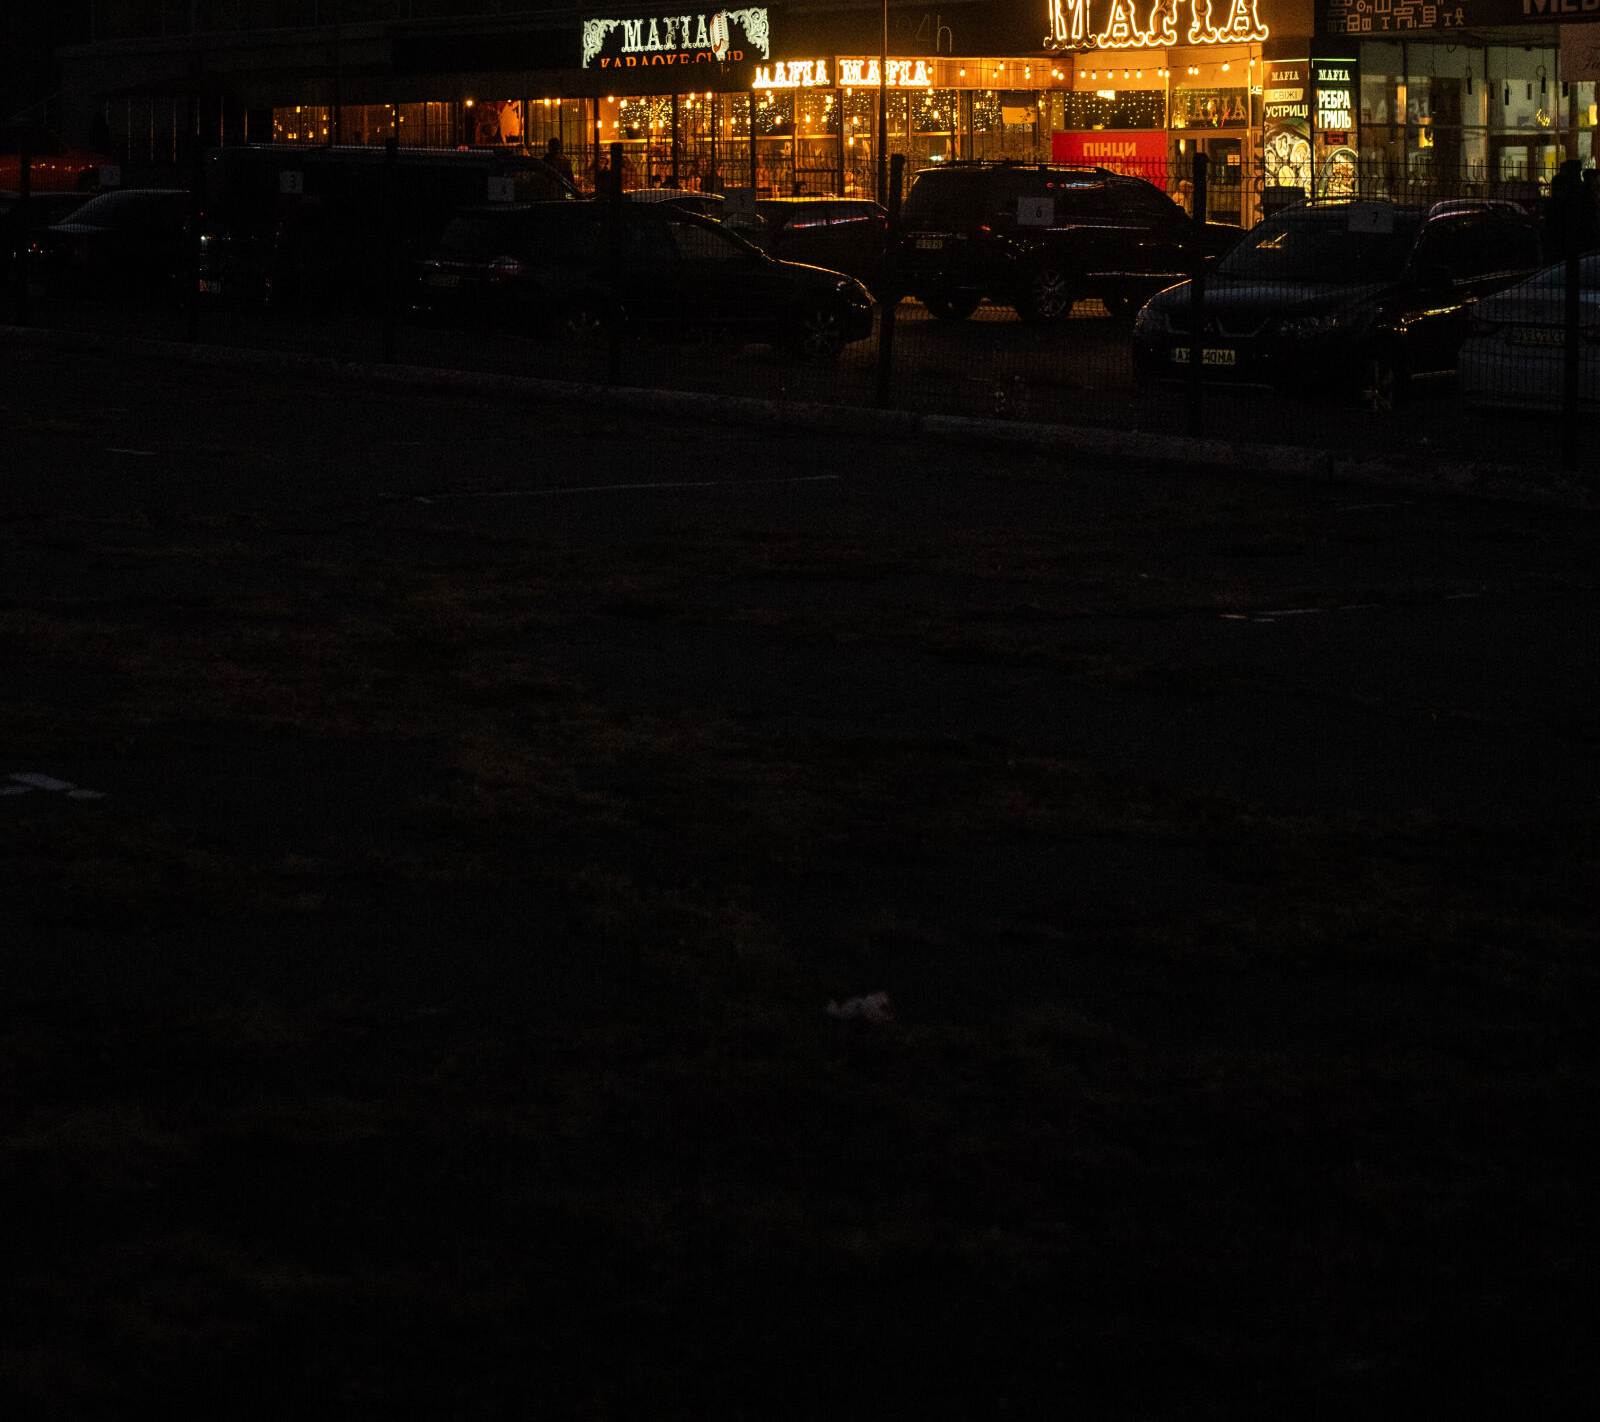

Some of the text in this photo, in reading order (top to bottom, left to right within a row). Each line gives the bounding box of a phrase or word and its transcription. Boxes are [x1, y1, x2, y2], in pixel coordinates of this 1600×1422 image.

[621, 14, 712, 53] MAFIA
[1271, 70, 1300, 81] MAFIA
[1318, 69, 1350, 81] MAFIA
[1318, 90, 1351, 109] РЕБРА
[1265, 104, 1309, 119] УСТРИЦІ
[1318, 110, 1352, 129] ГРИЛЬ
[1083, 142, 1137, 159] ПІНЦИ
